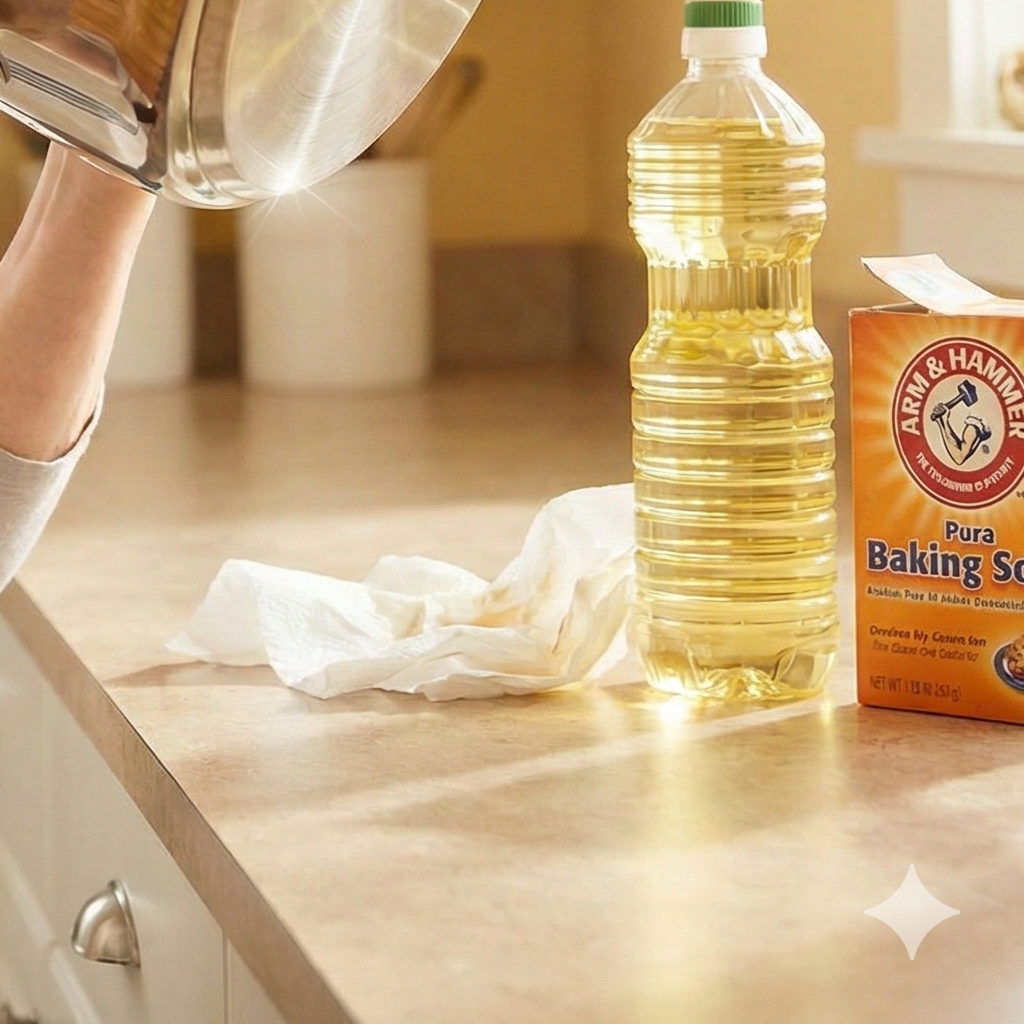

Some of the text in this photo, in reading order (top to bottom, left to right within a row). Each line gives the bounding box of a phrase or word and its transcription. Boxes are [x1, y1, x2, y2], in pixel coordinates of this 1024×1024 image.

[901, 347, 1024, 440] ARM & HAMMER
[944, 519, 996, 545] Pura
[867, 539, 983, 590] Baking
